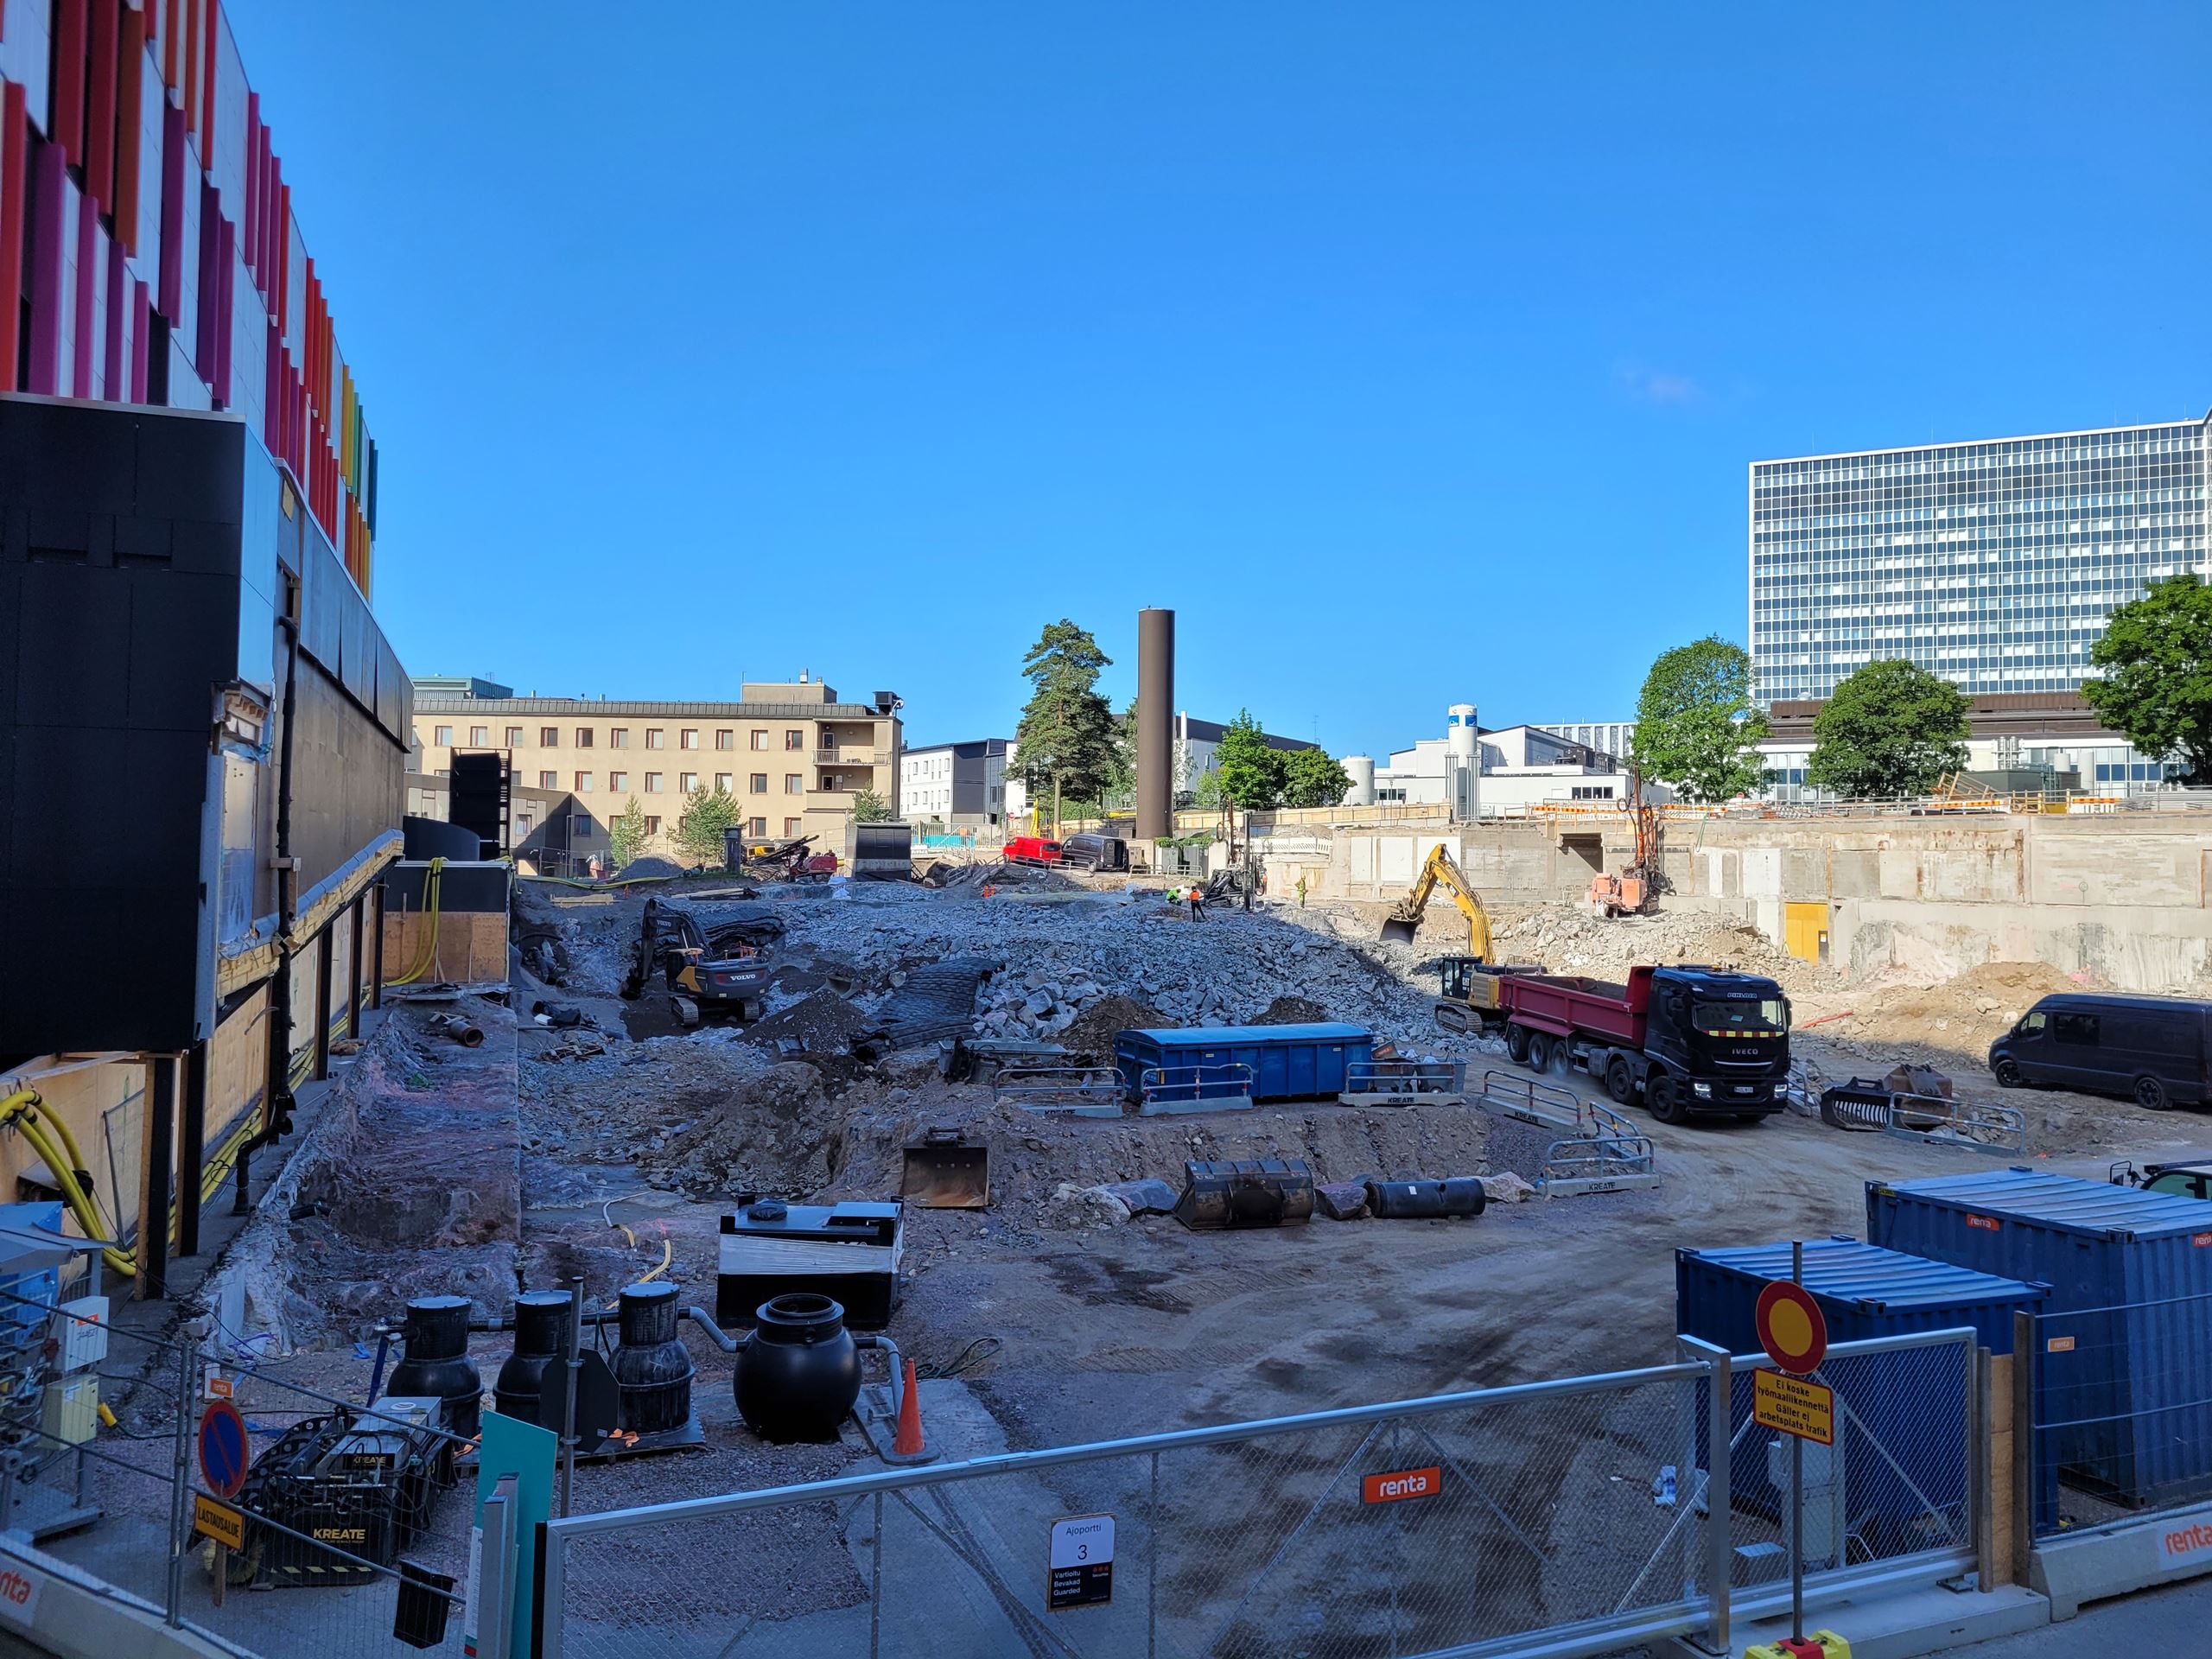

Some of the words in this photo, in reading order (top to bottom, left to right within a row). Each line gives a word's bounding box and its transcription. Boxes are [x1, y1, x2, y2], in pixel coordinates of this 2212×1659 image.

[1588, 1181, 1616, 1191] KREATE
[1776, 1379, 1784, 1389] Ei
[1786, 1381, 1810, 1397] koske
[1758, 1385, 1828, 1414] työmaaliikennettä
[1776, 1403, 1800, 1418] Gäller
[1802, 1413, 1809, 1421] ej
[1759, 1411, 1803, 1430] arbetsplats
[1806, 1423, 1827, 1438] trafik
[1379, 1475, 1427, 1497] renta
[198, 1506, 239, 1538] LASTAUSALUE
[1065, 1523, 1102, 1536] Ajoportti
[313, 1528, 366, 1540] KREATE
[1077, 1544, 1088, 1560] 3
[1053, 1586, 1081, 1596] Guarded
[1054, 1579, 1081, 1587] Bevakad
